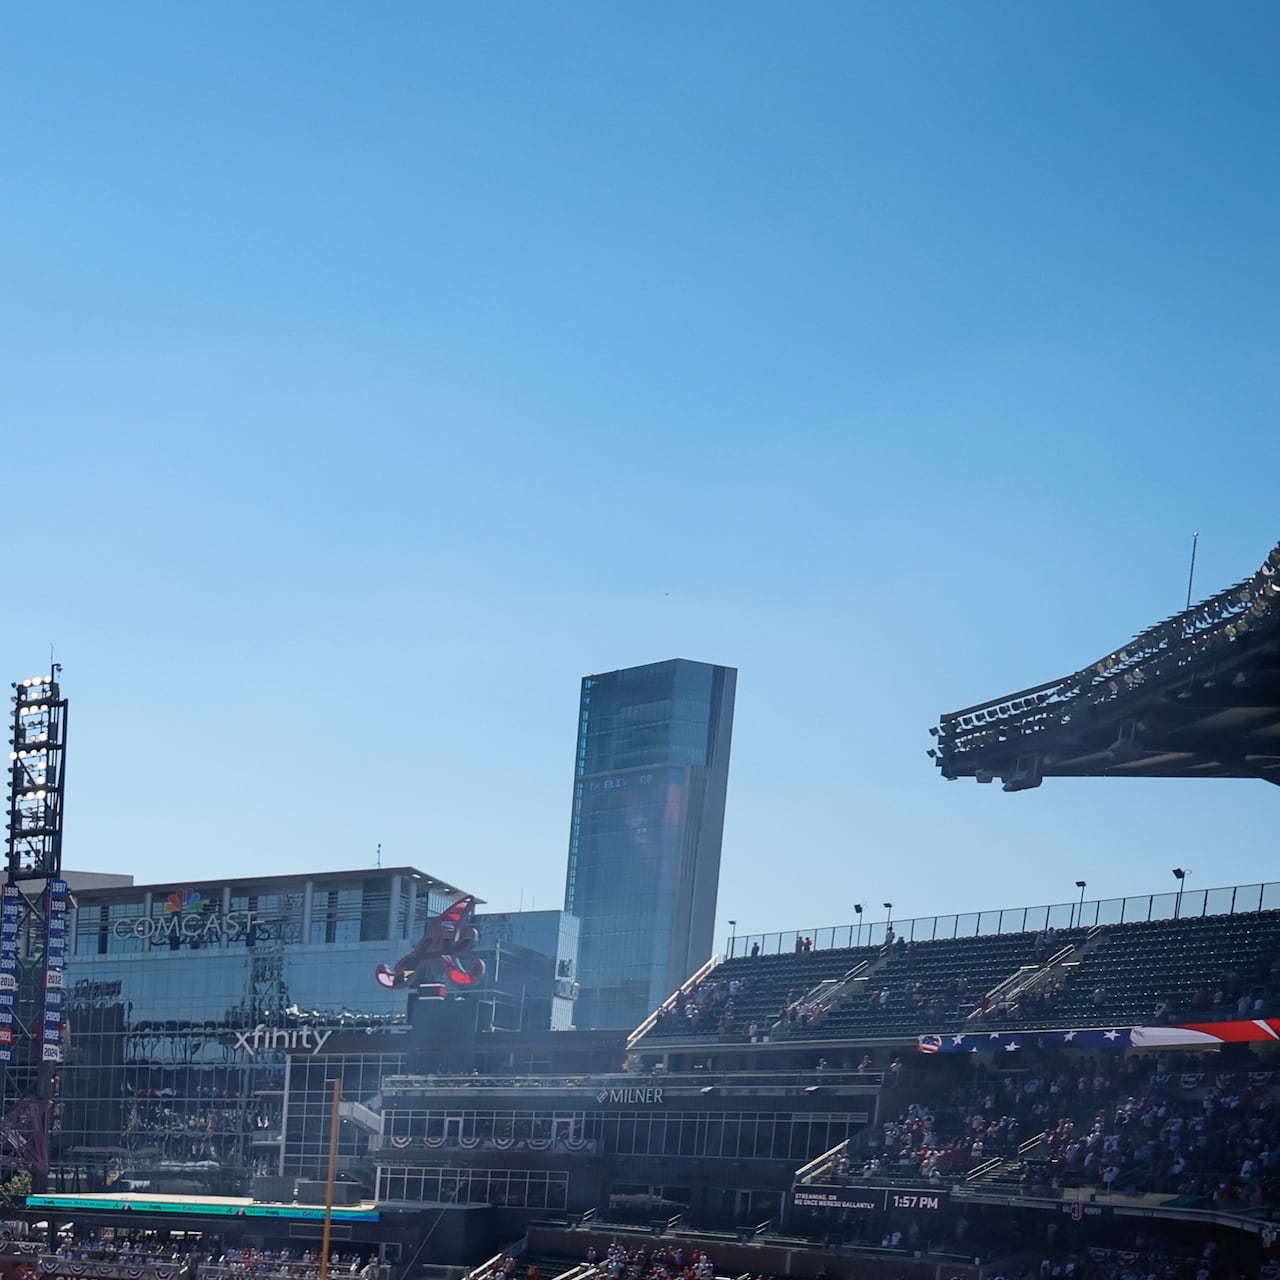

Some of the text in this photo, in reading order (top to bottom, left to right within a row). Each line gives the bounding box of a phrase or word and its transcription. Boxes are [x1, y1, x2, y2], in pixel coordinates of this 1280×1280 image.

[53, 883, 66, 892] 1997
[51, 920, 64, 929] 2001
[113, 911, 257, 939] COMCAST
[48, 974, 62, 985] 2012
[45, 1029, 59, 1040] 2022
[233, 1023, 333, 1055] xfinity
[44, 1047, 58, 1057] 2024
[609, 1088, 663, 1103] MILNER
[893, 1196, 939, 1209] 1:57 PM
[1072, 1201, 1082, 1221] 3
